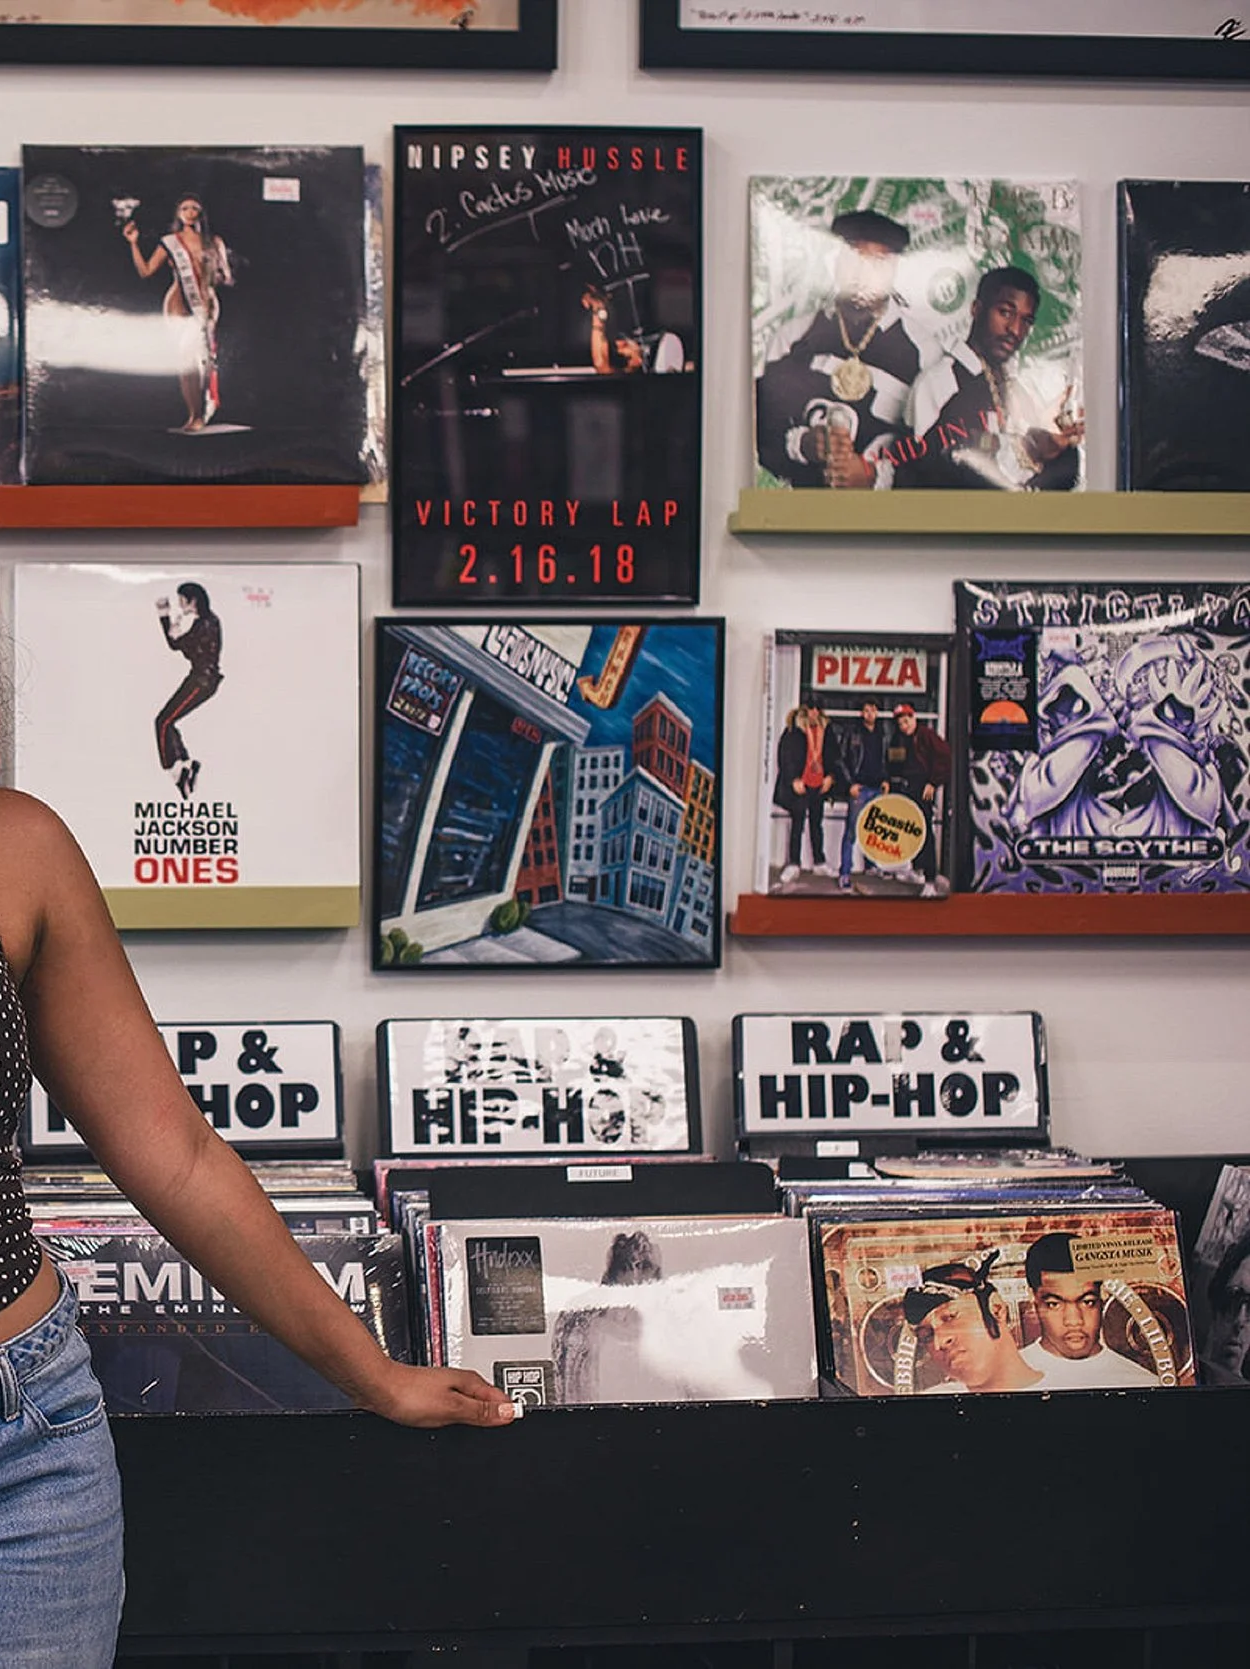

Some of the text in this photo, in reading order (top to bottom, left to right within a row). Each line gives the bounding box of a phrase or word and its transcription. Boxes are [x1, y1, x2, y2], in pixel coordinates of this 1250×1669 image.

[406, 144, 689, 171] NIPSEY HUSSLE
[416, 500, 678, 527] VICTORY LAP
[458, 543, 634, 583] 2.16.18
[816, 655, 922, 688] PIZZA
[134, 802, 238, 818] MICHAEL
[869, 804, 922, 837] Beastie
[134, 821, 238, 836] JACKSON
[863, 818, 899, 842] Boys
[134, 839, 238, 854] NUMBER
[866, 833, 902, 859] Book
[1035, 839, 1208, 858] THE SCYTHE
[134, 857, 239, 884] ONES
[237, 1030, 283, 1075] &
[791, 1019, 986, 1065] RAP &
[759, 1072, 1021, 1119] HIP-HOP
[412, 1087, 667, 1145] HIP-HOP
[578, 1169, 621, 1178] FUTURE
[1075, 1247, 1153, 1262] GANGSTA MUSIK
[77, 1261, 367, 1301] EMIM
[80, 1303, 242, 1314] THE EMIN
[82, 1324, 227, 1334] EXPANDED
